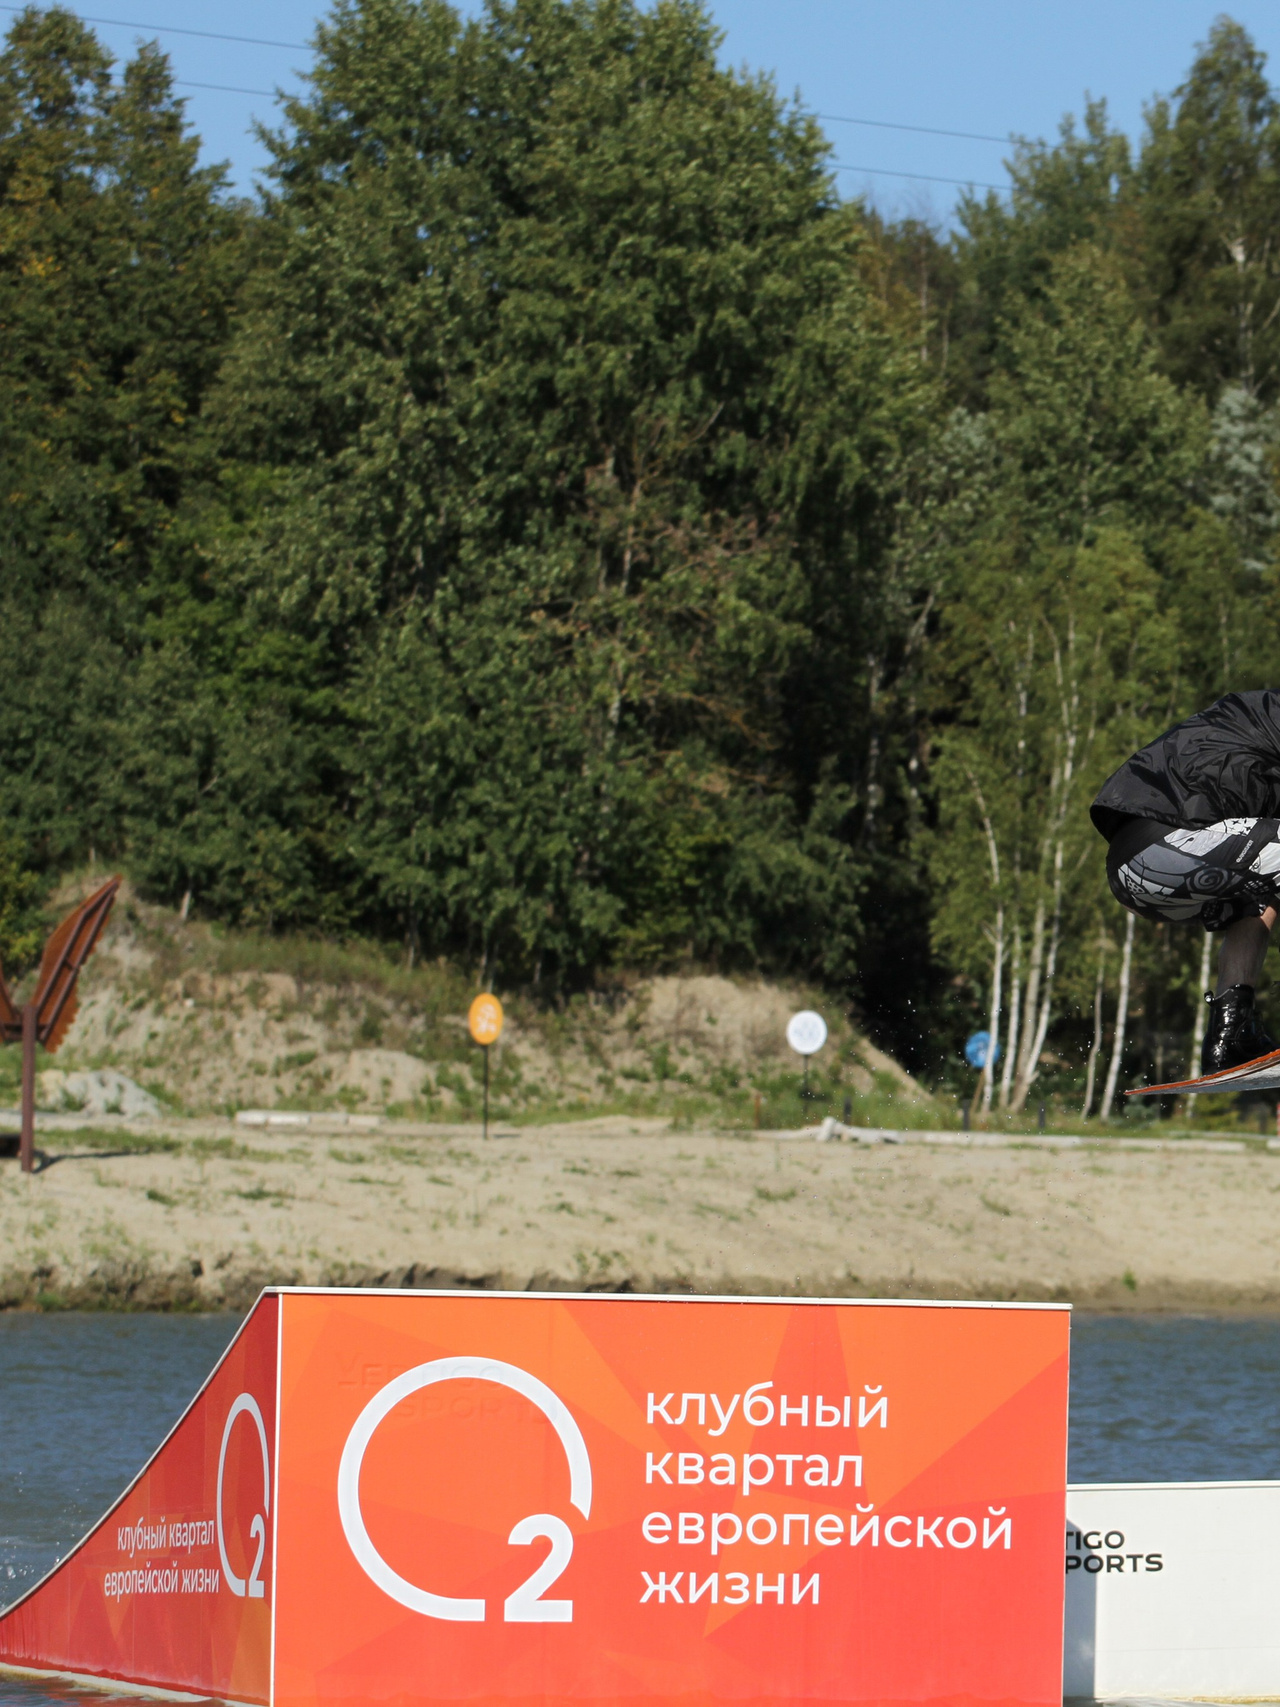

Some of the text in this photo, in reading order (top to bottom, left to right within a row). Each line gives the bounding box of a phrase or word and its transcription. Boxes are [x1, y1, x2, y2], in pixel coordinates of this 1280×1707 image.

[646, 1380, 889, 1437] клубный
[645, 1451, 863, 1496] квартал
[117, 1516, 215, 1559] клубный квартал
[641, 1502, 1012, 1556] европейской
[104, 1560, 220, 1603] европейской жизни
[1065, 1553, 1163, 1574] PORTS
[640, 1571, 820, 1605] жизни
